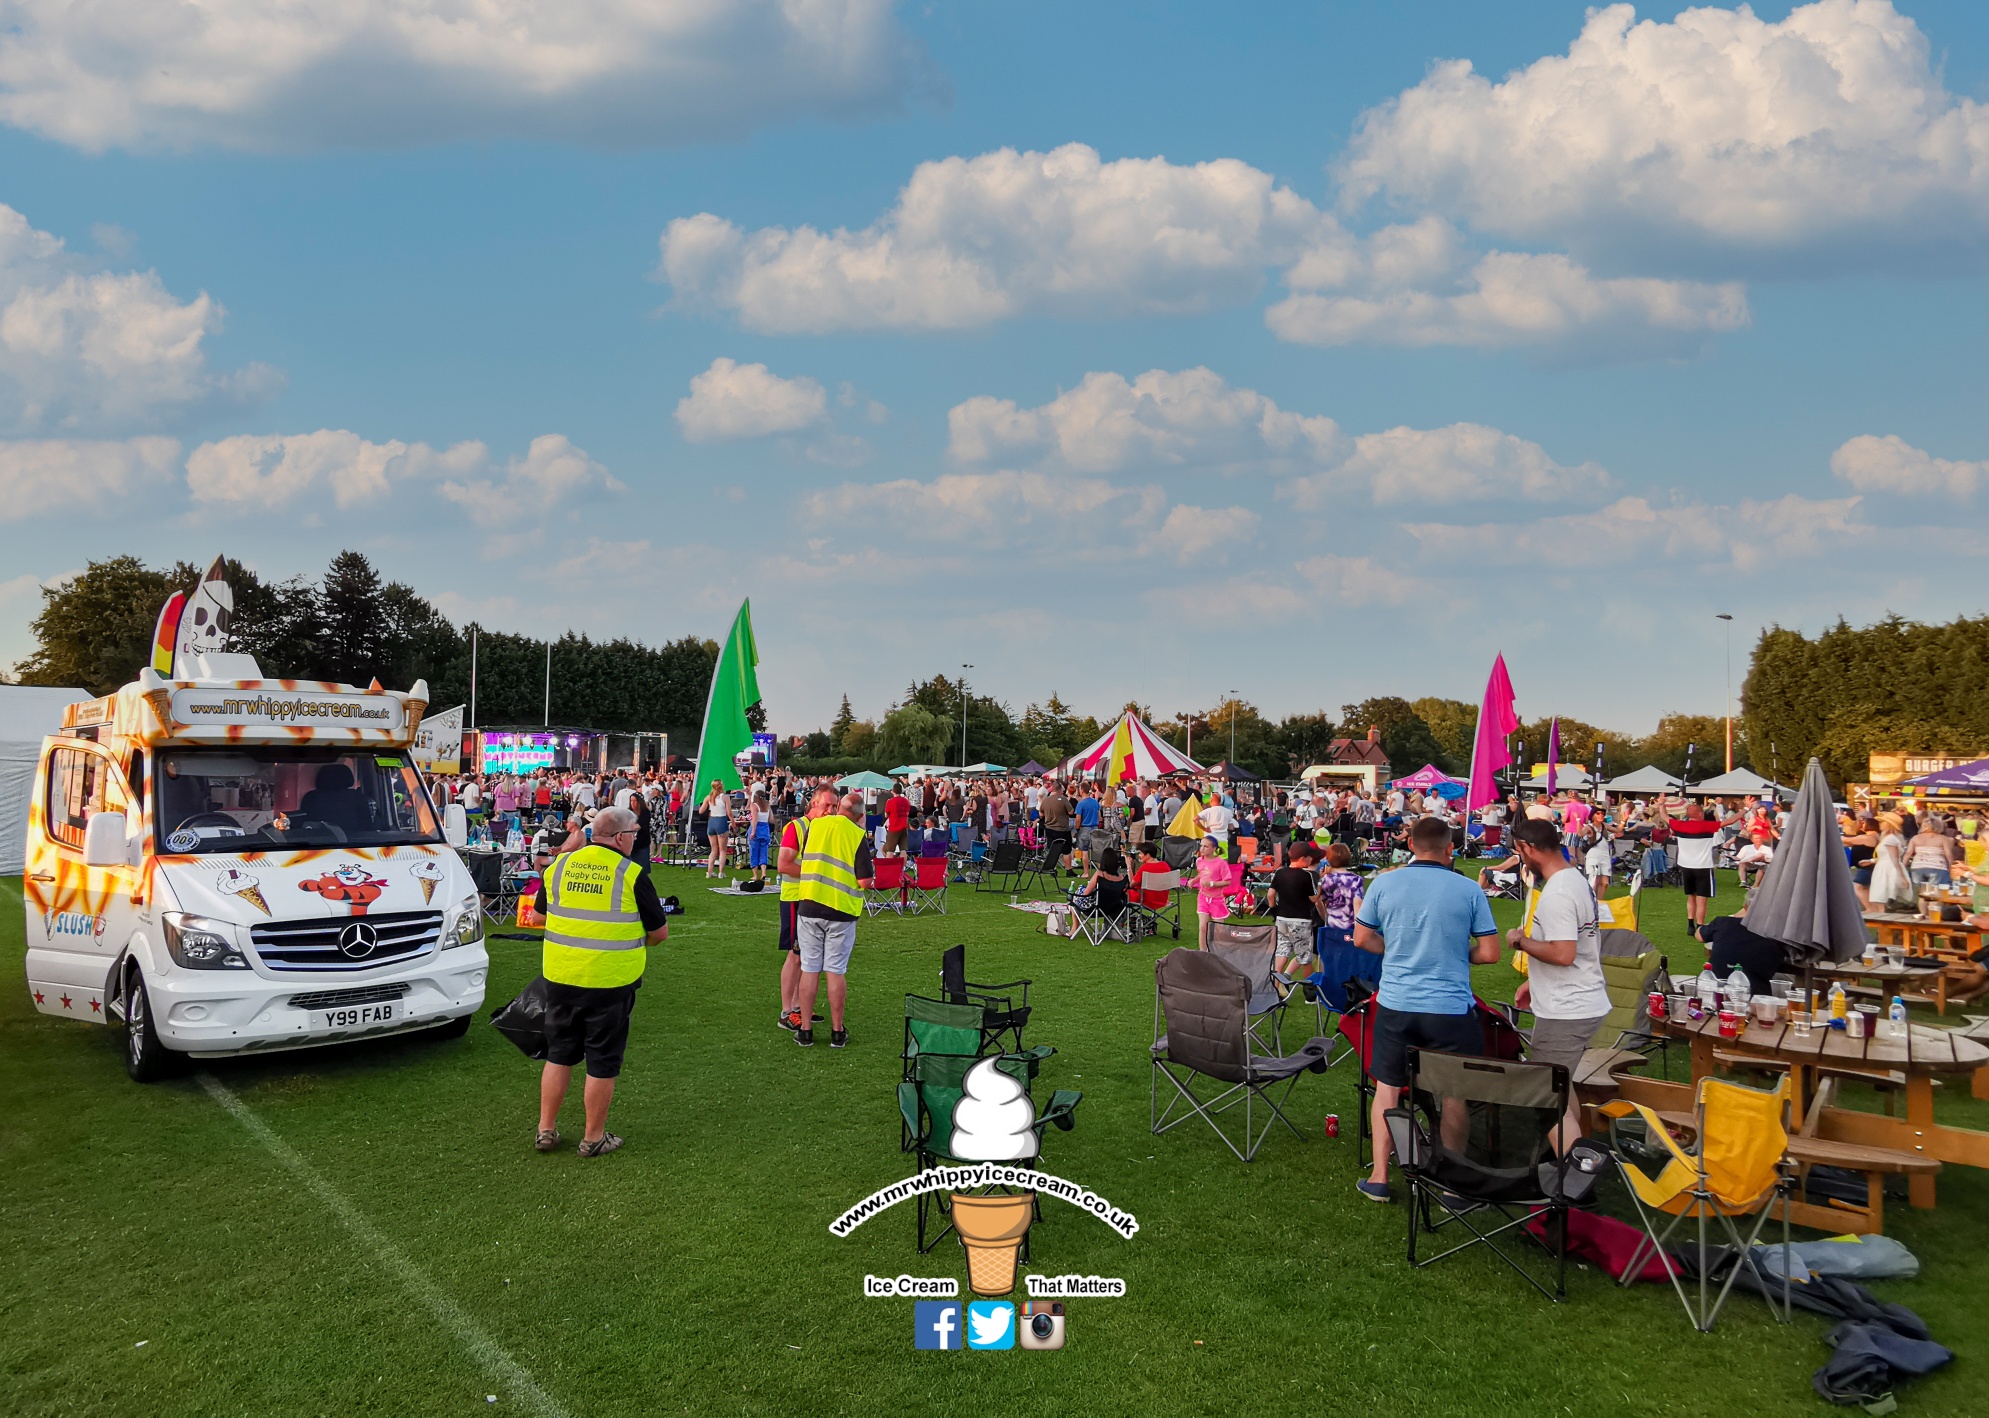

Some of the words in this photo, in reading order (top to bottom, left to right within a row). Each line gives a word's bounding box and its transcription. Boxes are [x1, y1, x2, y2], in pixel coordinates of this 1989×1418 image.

[190, 695, 389, 721] www.mrwhippyicecream.co.uk
[1905, 759, 1954, 772] BURGER
[172, 834, 194, 846] 009
[570, 861, 608, 872] Stockport
[565, 870, 590, 880] Rugby
[591, 872, 611, 882] Club
[566, 881, 603, 895] OFFICIAL
[56, 912, 94, 937] SLUSH
[326, 1009, 358, 1027] Y99
[362, 1005, 392, 1022] FAB
